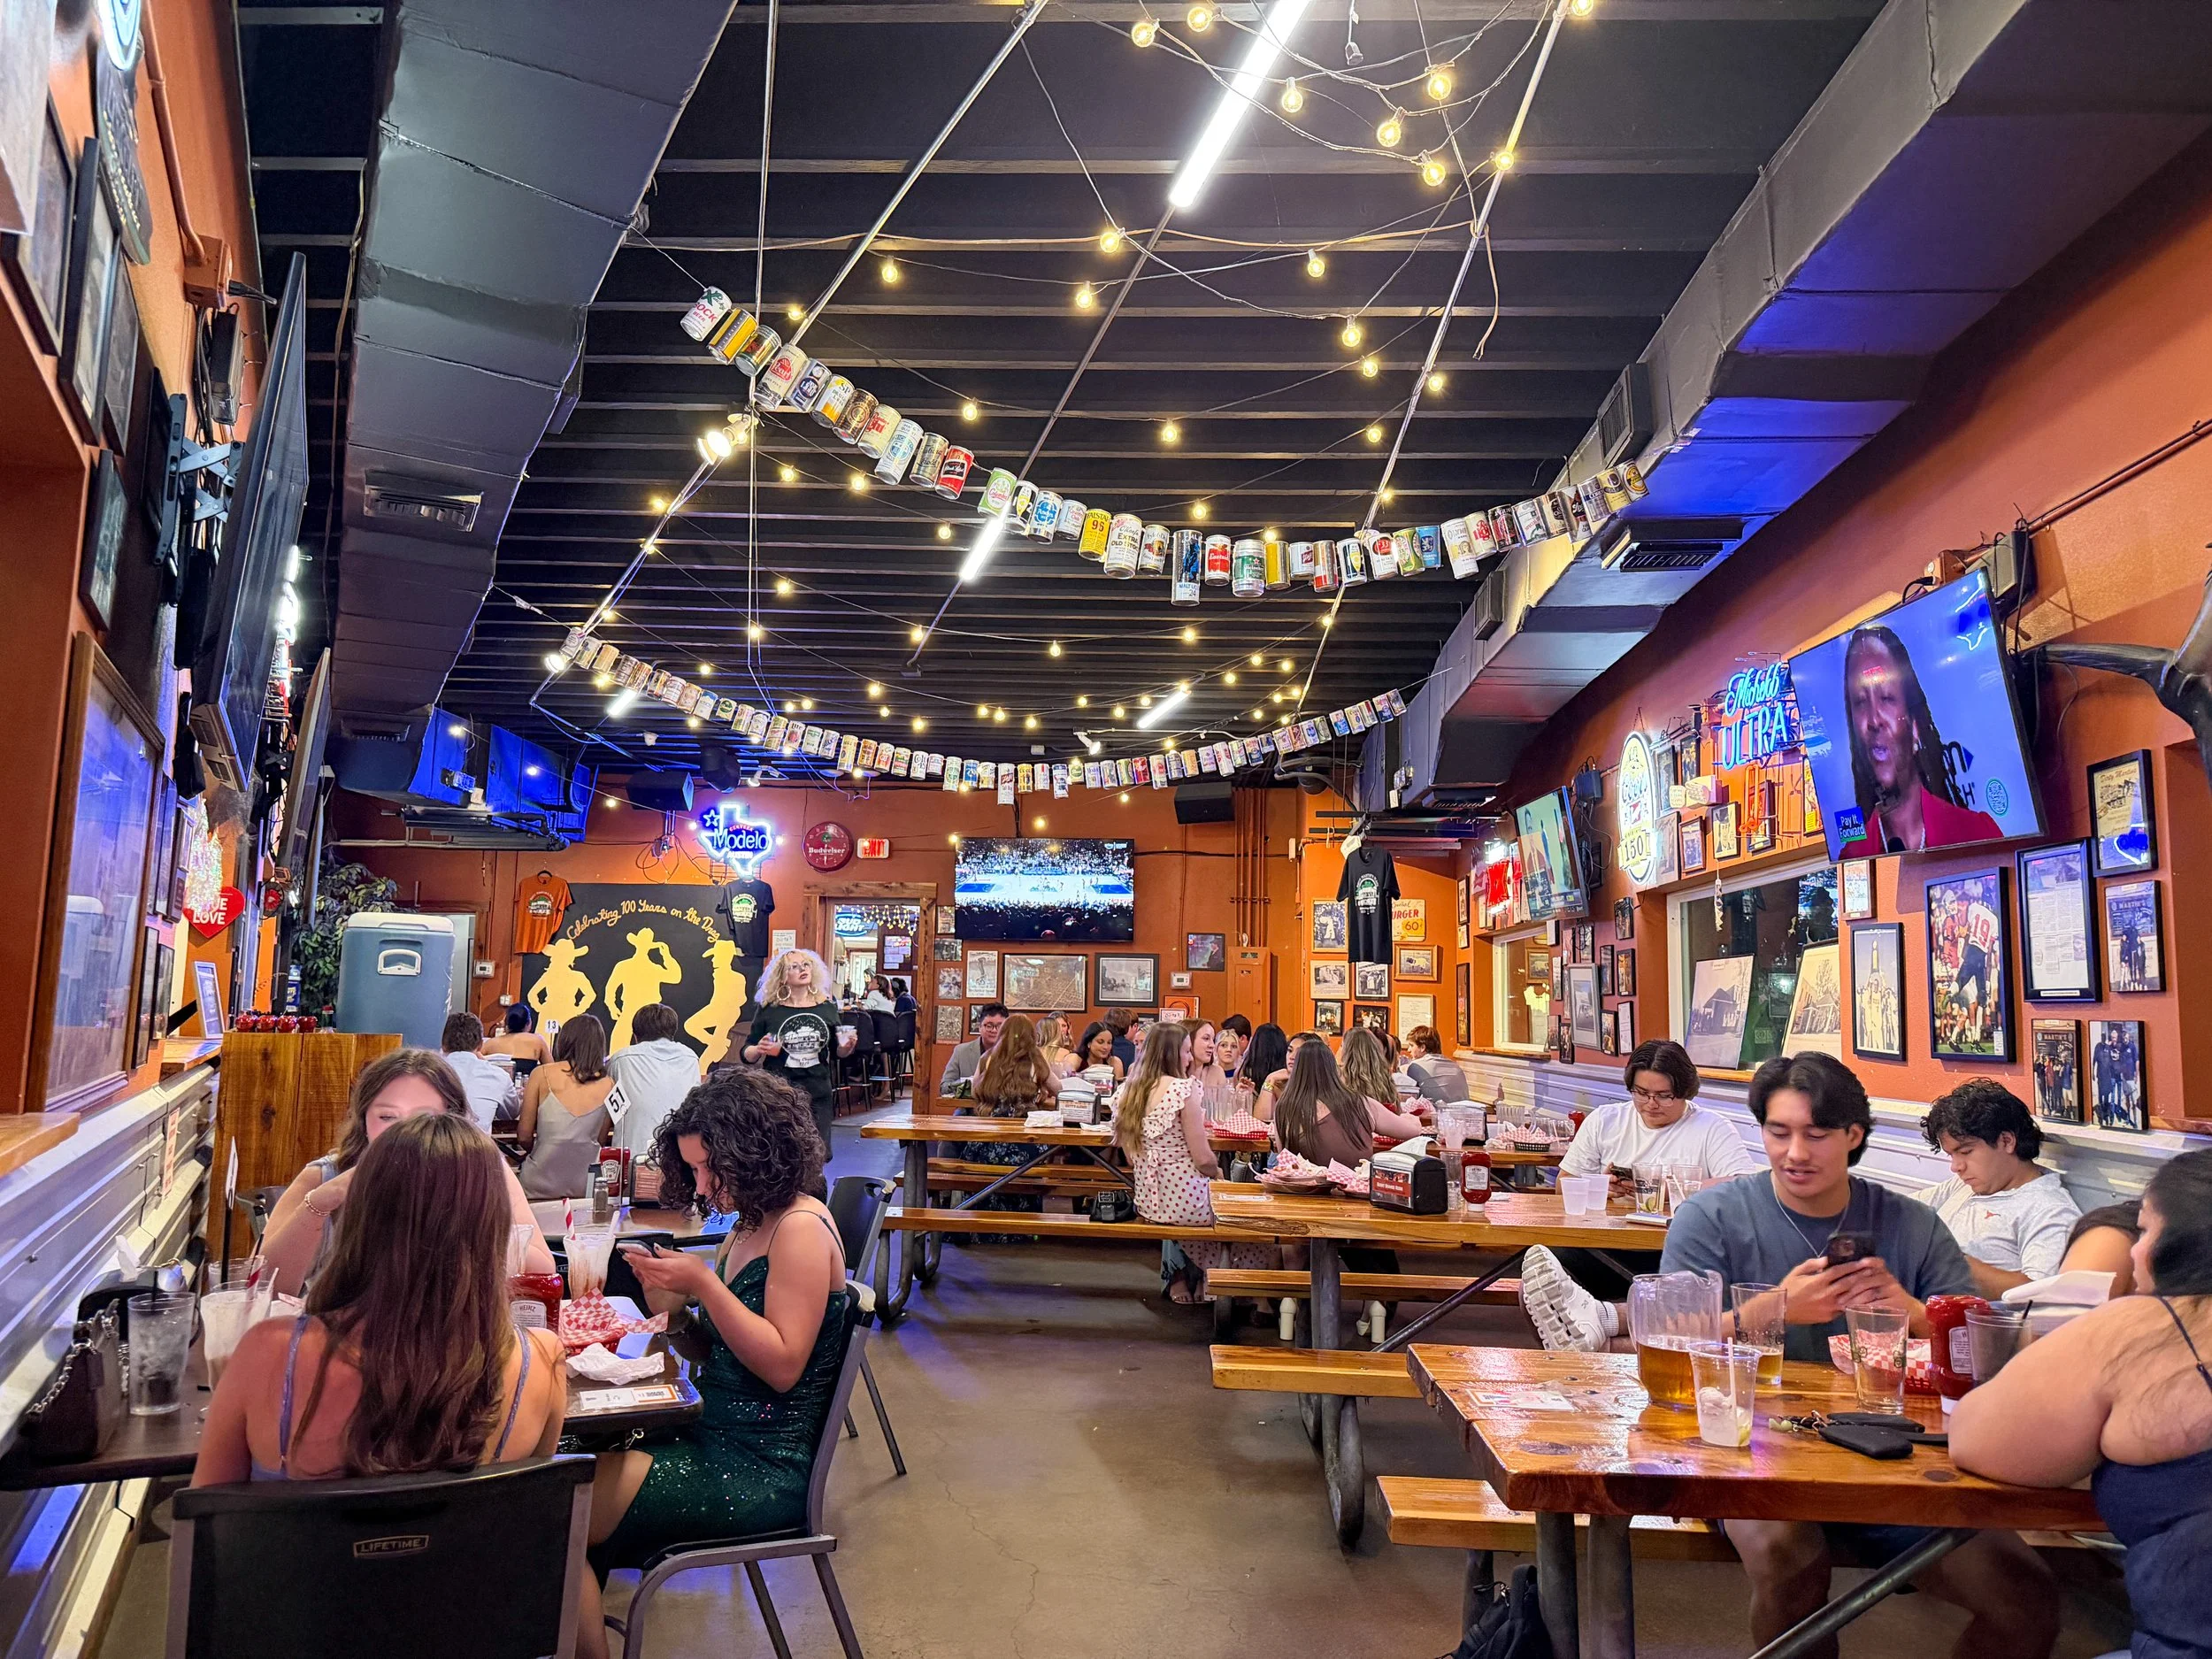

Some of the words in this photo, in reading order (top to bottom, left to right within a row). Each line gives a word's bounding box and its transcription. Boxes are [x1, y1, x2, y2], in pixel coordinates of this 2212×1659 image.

[693, 311, 706, 322] BEER
[770, 361, 791, 378] Pearl
[1092, 519, 1105, 532] 96
[1118, 532, 1139, 543] EXTRA
[1124, 541, 1139, 550] STOC
[1188, 588, 1197, 597] 24
[1722, 702, 1787, 770] ULTRA
[1840, 816, 1852, 826] Pay
[1839, 823, 1866, 839] Forward
[711, 828, 768, 849] Modelo
[1624, 834, 1644, 863] 150
[193, 911, 226, 925] LOVE
[567, 909, 622, 940] Celebrating
[620, 899, 636, 915] 100
[637, 899, 668, 913] Years
[670, 908, 682, 918] on
[683, 907, 702, 926] the
[701, 916, 721, 943] Drag
[1392, 909, 1419, 920] URGER
[1974, 912, 1991, 948] 19
[547, 1020, 557, 1030] 13
[609, 1086, 626, 1113] 51
[361, 1539, 420, 1552] LIFETIME
